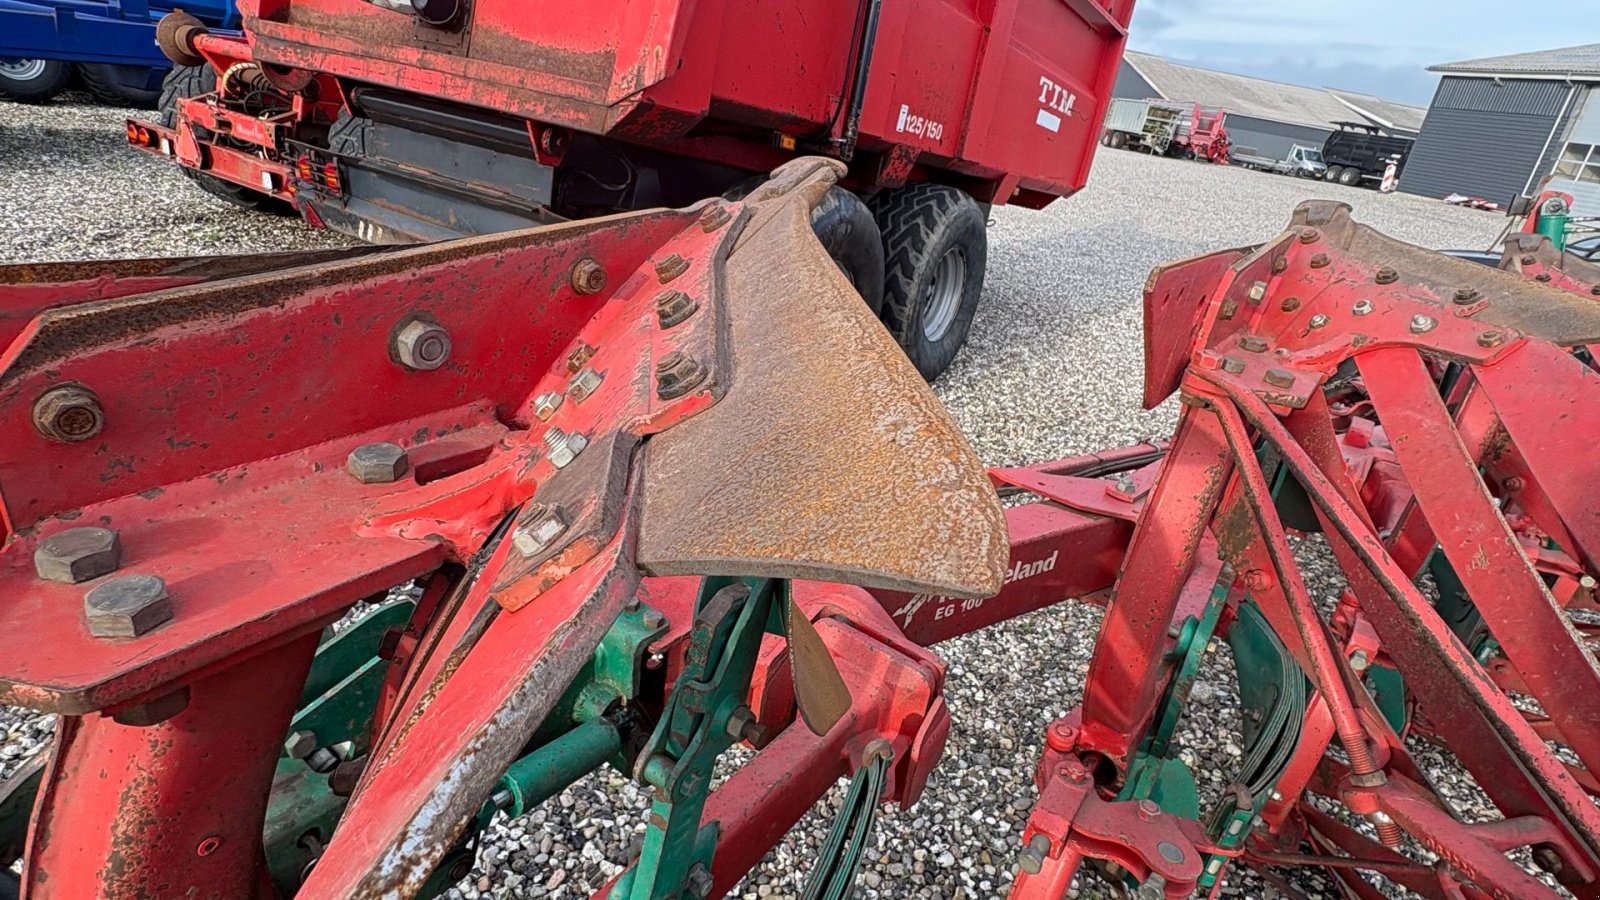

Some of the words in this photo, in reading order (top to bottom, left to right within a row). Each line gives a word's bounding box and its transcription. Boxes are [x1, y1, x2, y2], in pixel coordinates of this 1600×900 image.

[1038, 75, 1076, 117] TIM
[905, 114, 943, 141] 125/150
[934, 604, 955, 621] EG
[960, 598, 984, 612] 100
